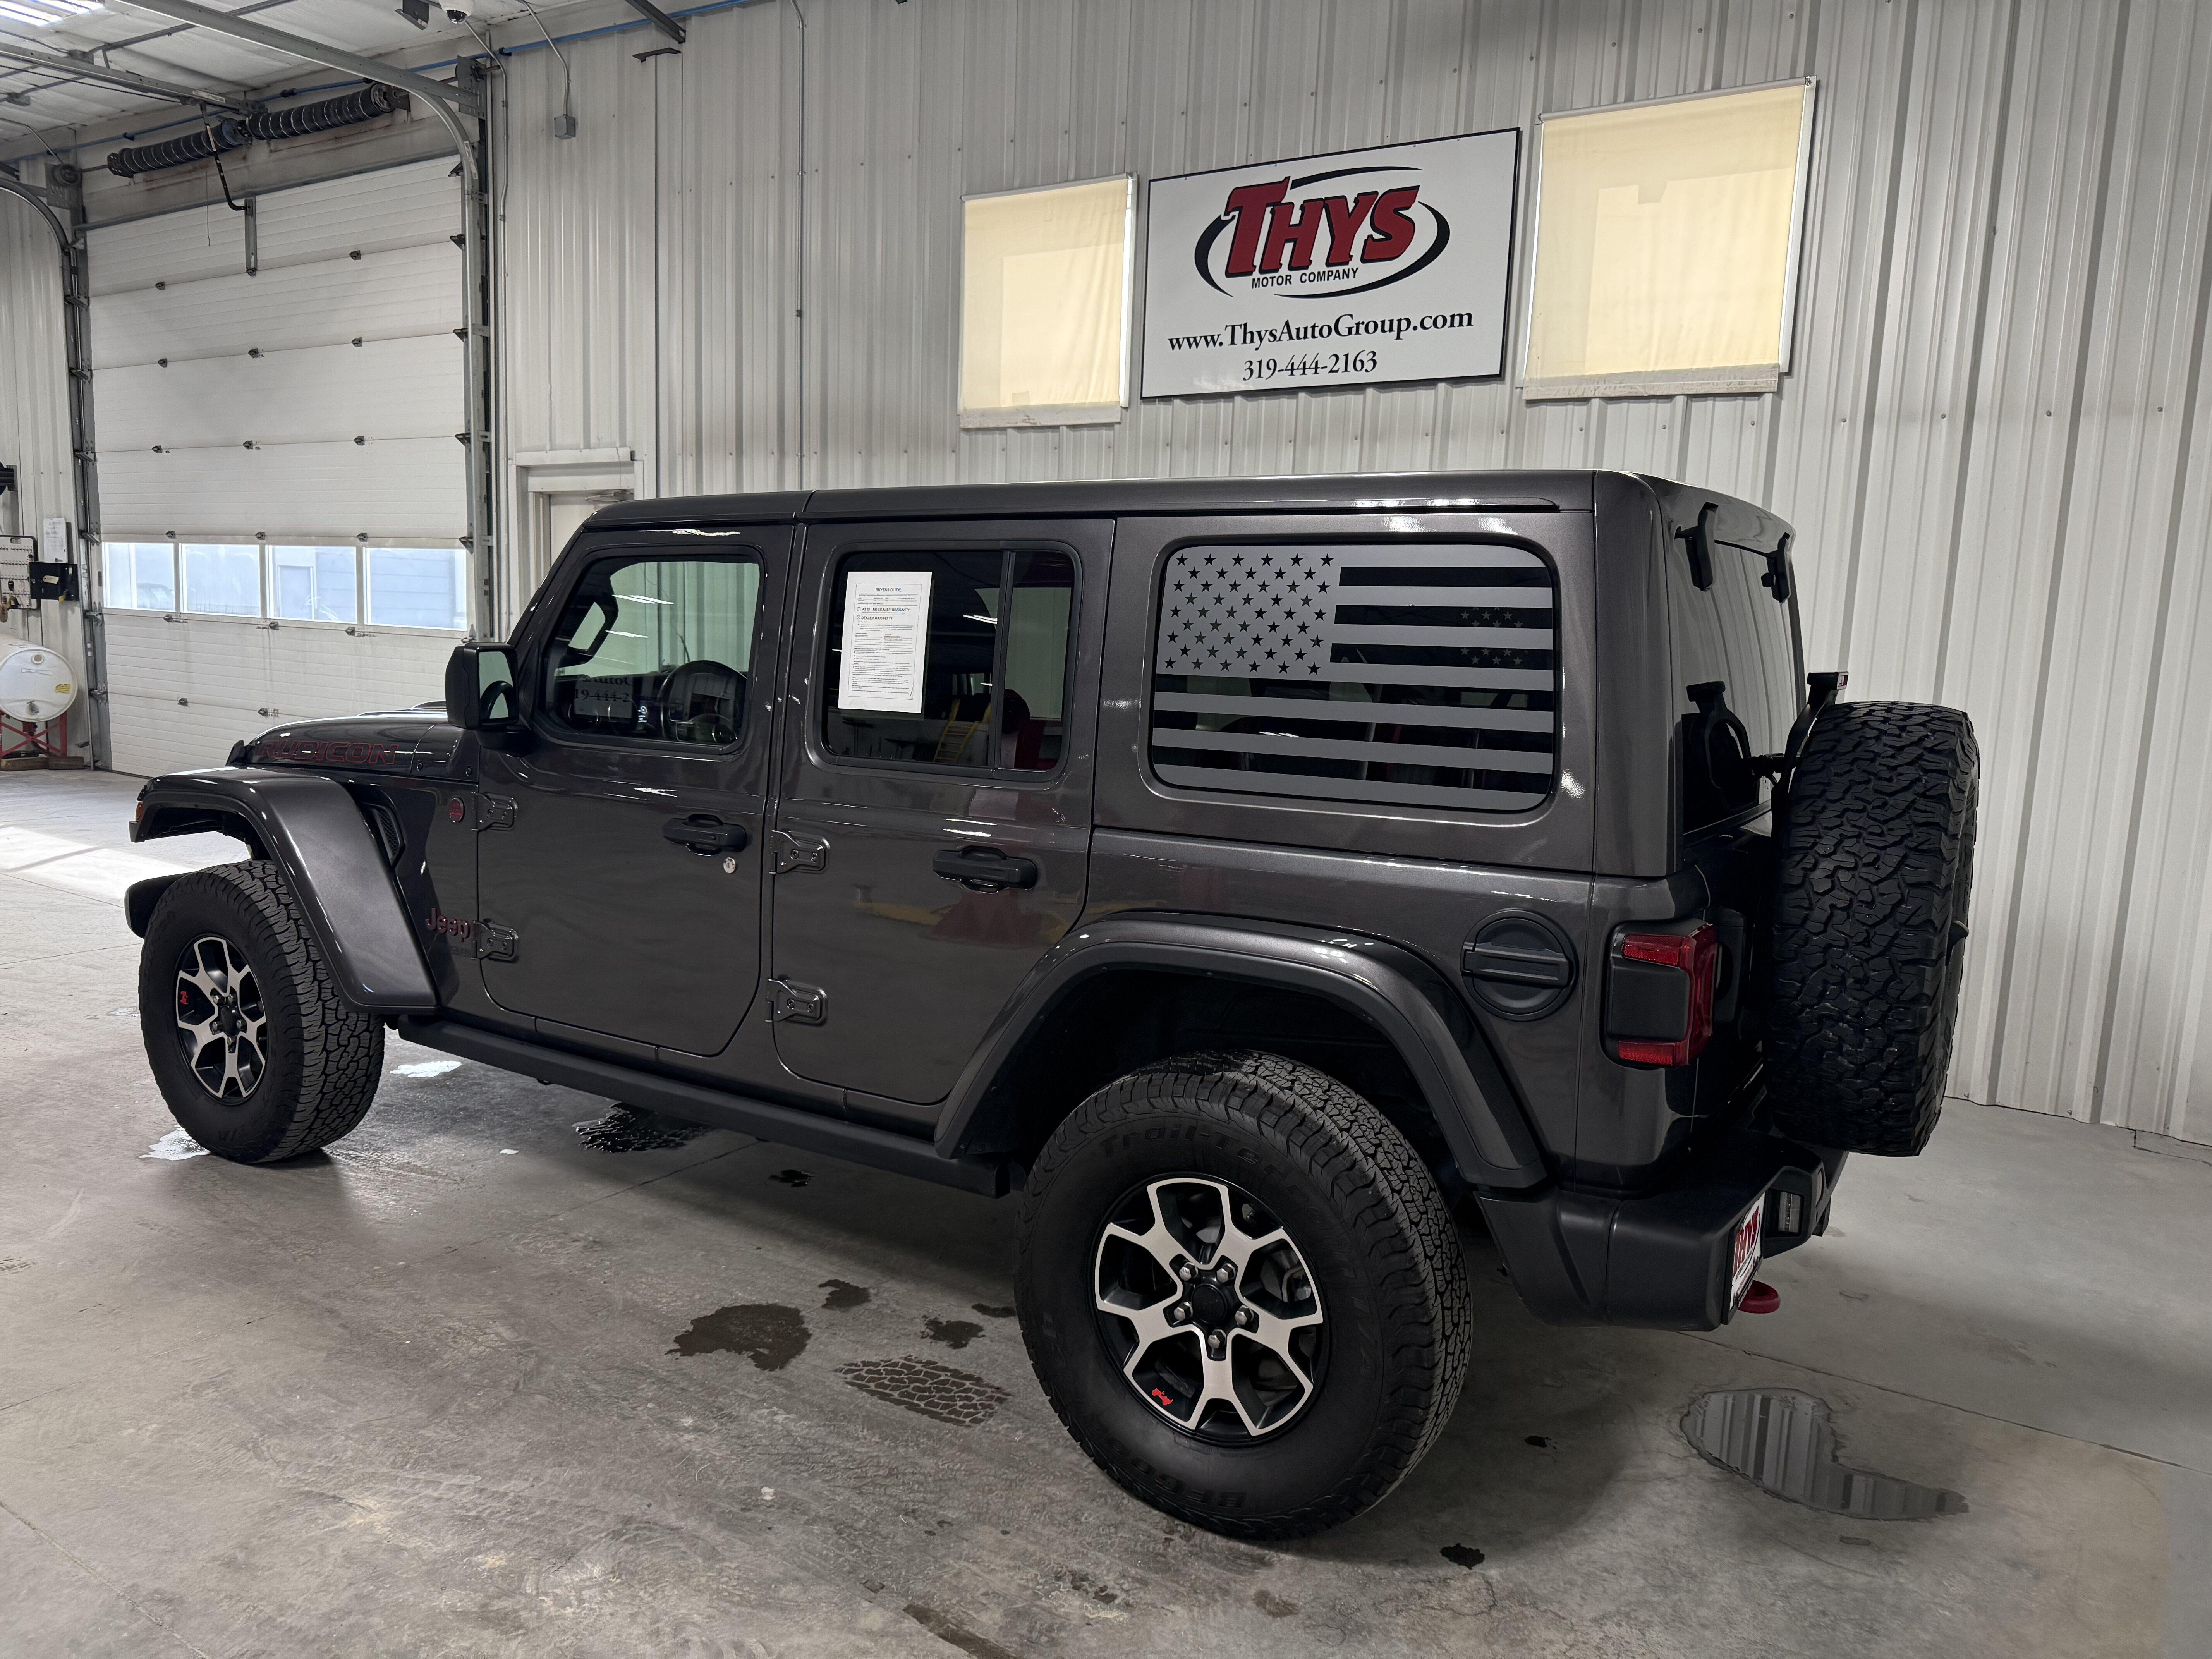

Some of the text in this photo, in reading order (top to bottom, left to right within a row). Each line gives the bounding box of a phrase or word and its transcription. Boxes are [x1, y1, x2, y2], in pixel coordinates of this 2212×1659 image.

[1223, 176, 1421, 279] THYS
[1251, 267, 1360, 289] MOTOR COMPANY
[1167, 312, 1474, 352] www.ThysAutoGroup.com
[1242, 350, 1378, 381] 319-444-2163
[257, 739, 399, 765] RUBICON
[425, 908, 470, 943] Jeep
